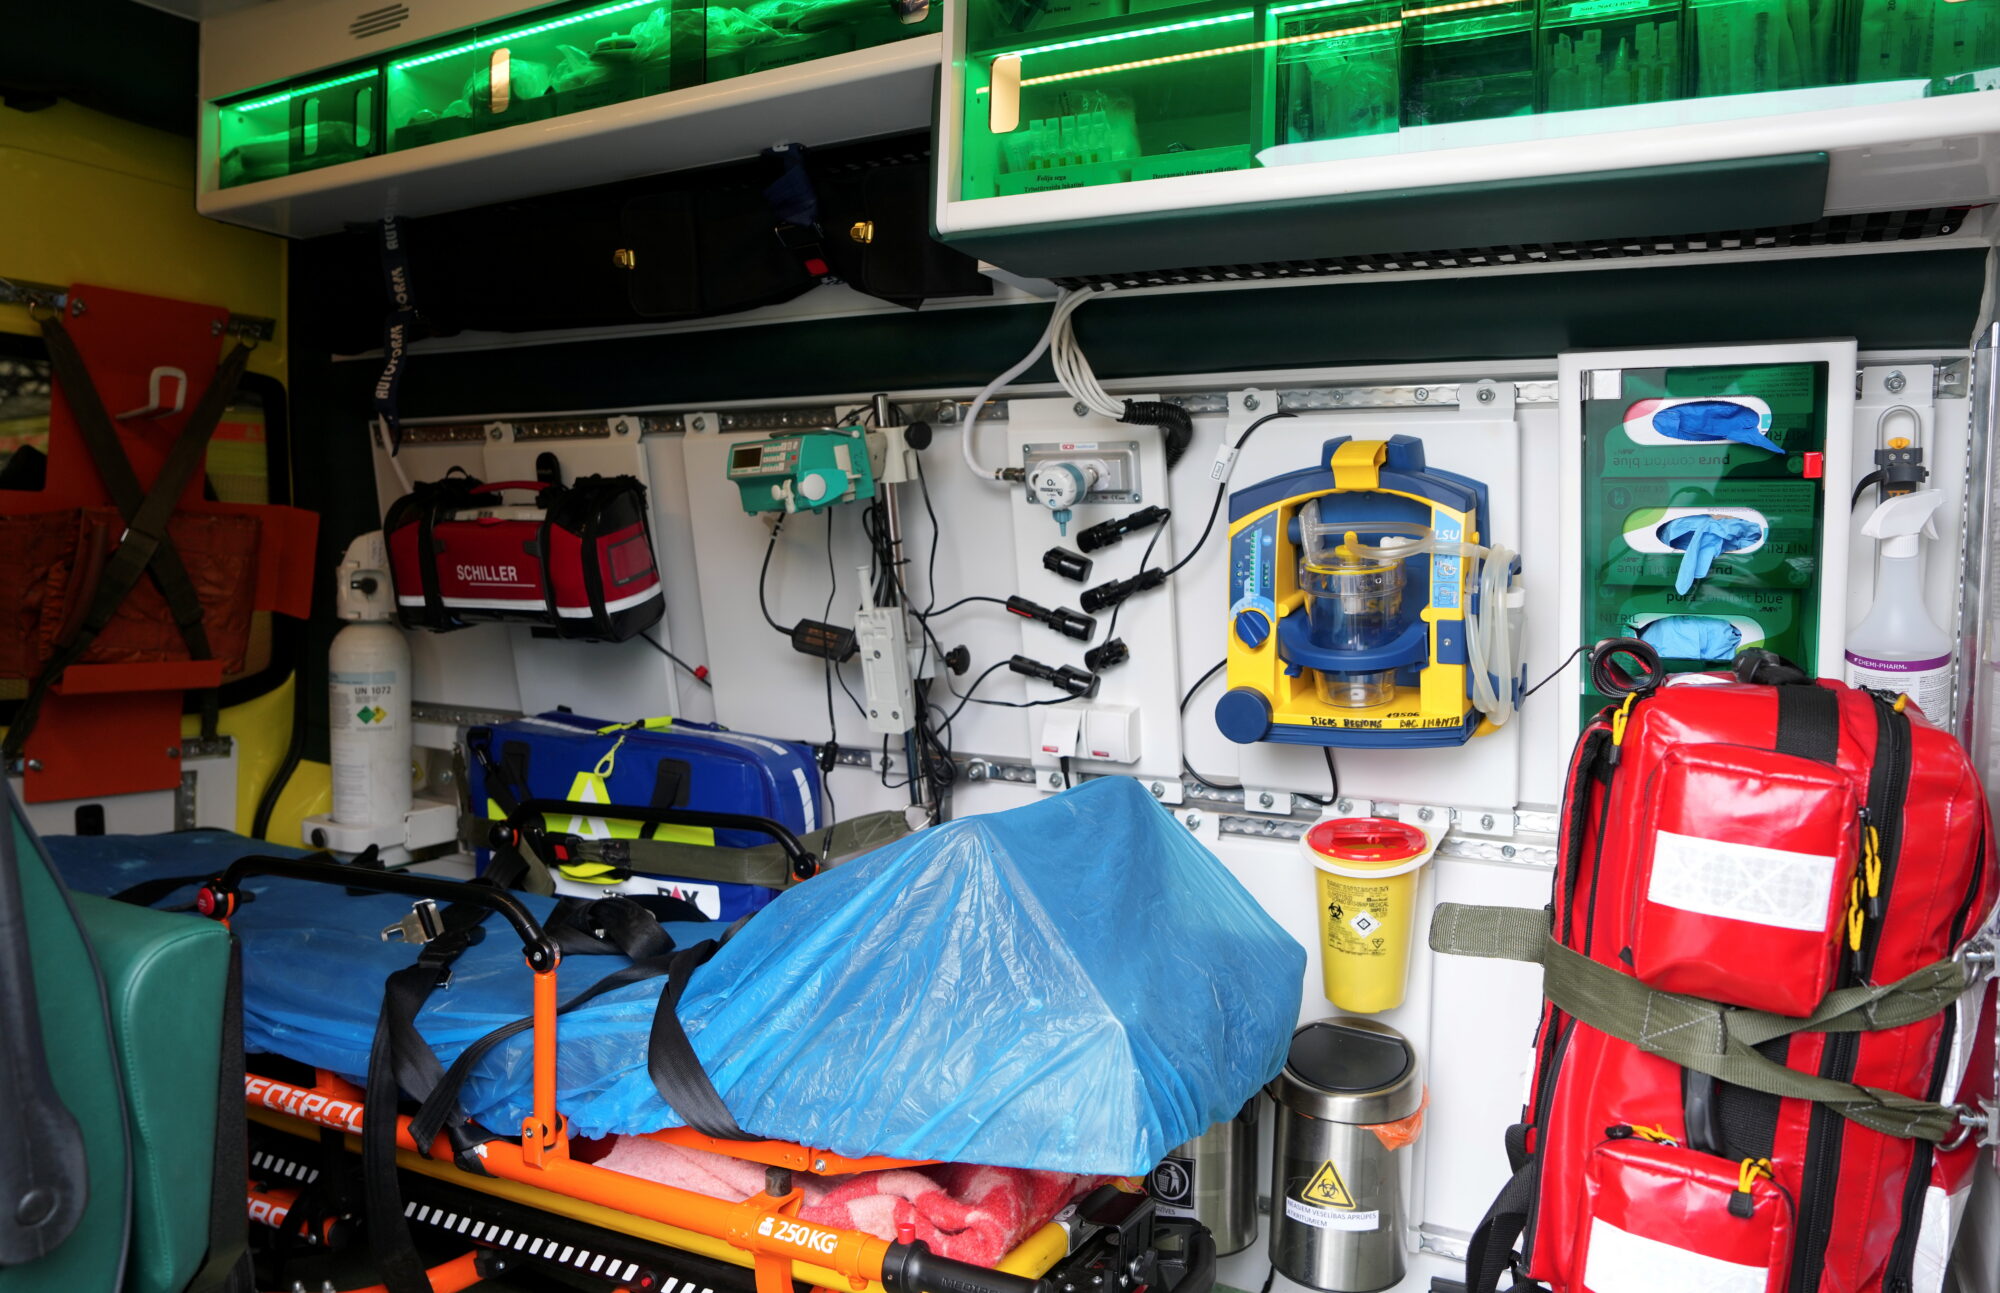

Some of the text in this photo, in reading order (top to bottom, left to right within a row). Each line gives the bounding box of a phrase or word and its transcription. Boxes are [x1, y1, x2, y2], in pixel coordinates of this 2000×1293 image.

[1613, 457, 1640, 469] blue
[1698, 454, 1730, 466] pura
[1435, 529, 1460, 541] LSU
[456, 563, 518, 582] SCHILLER
[1616, 565, 1643, 576] blue
[1754, 593, 1783, 604] blue
[354, 686, 391, 695] UN 1072
